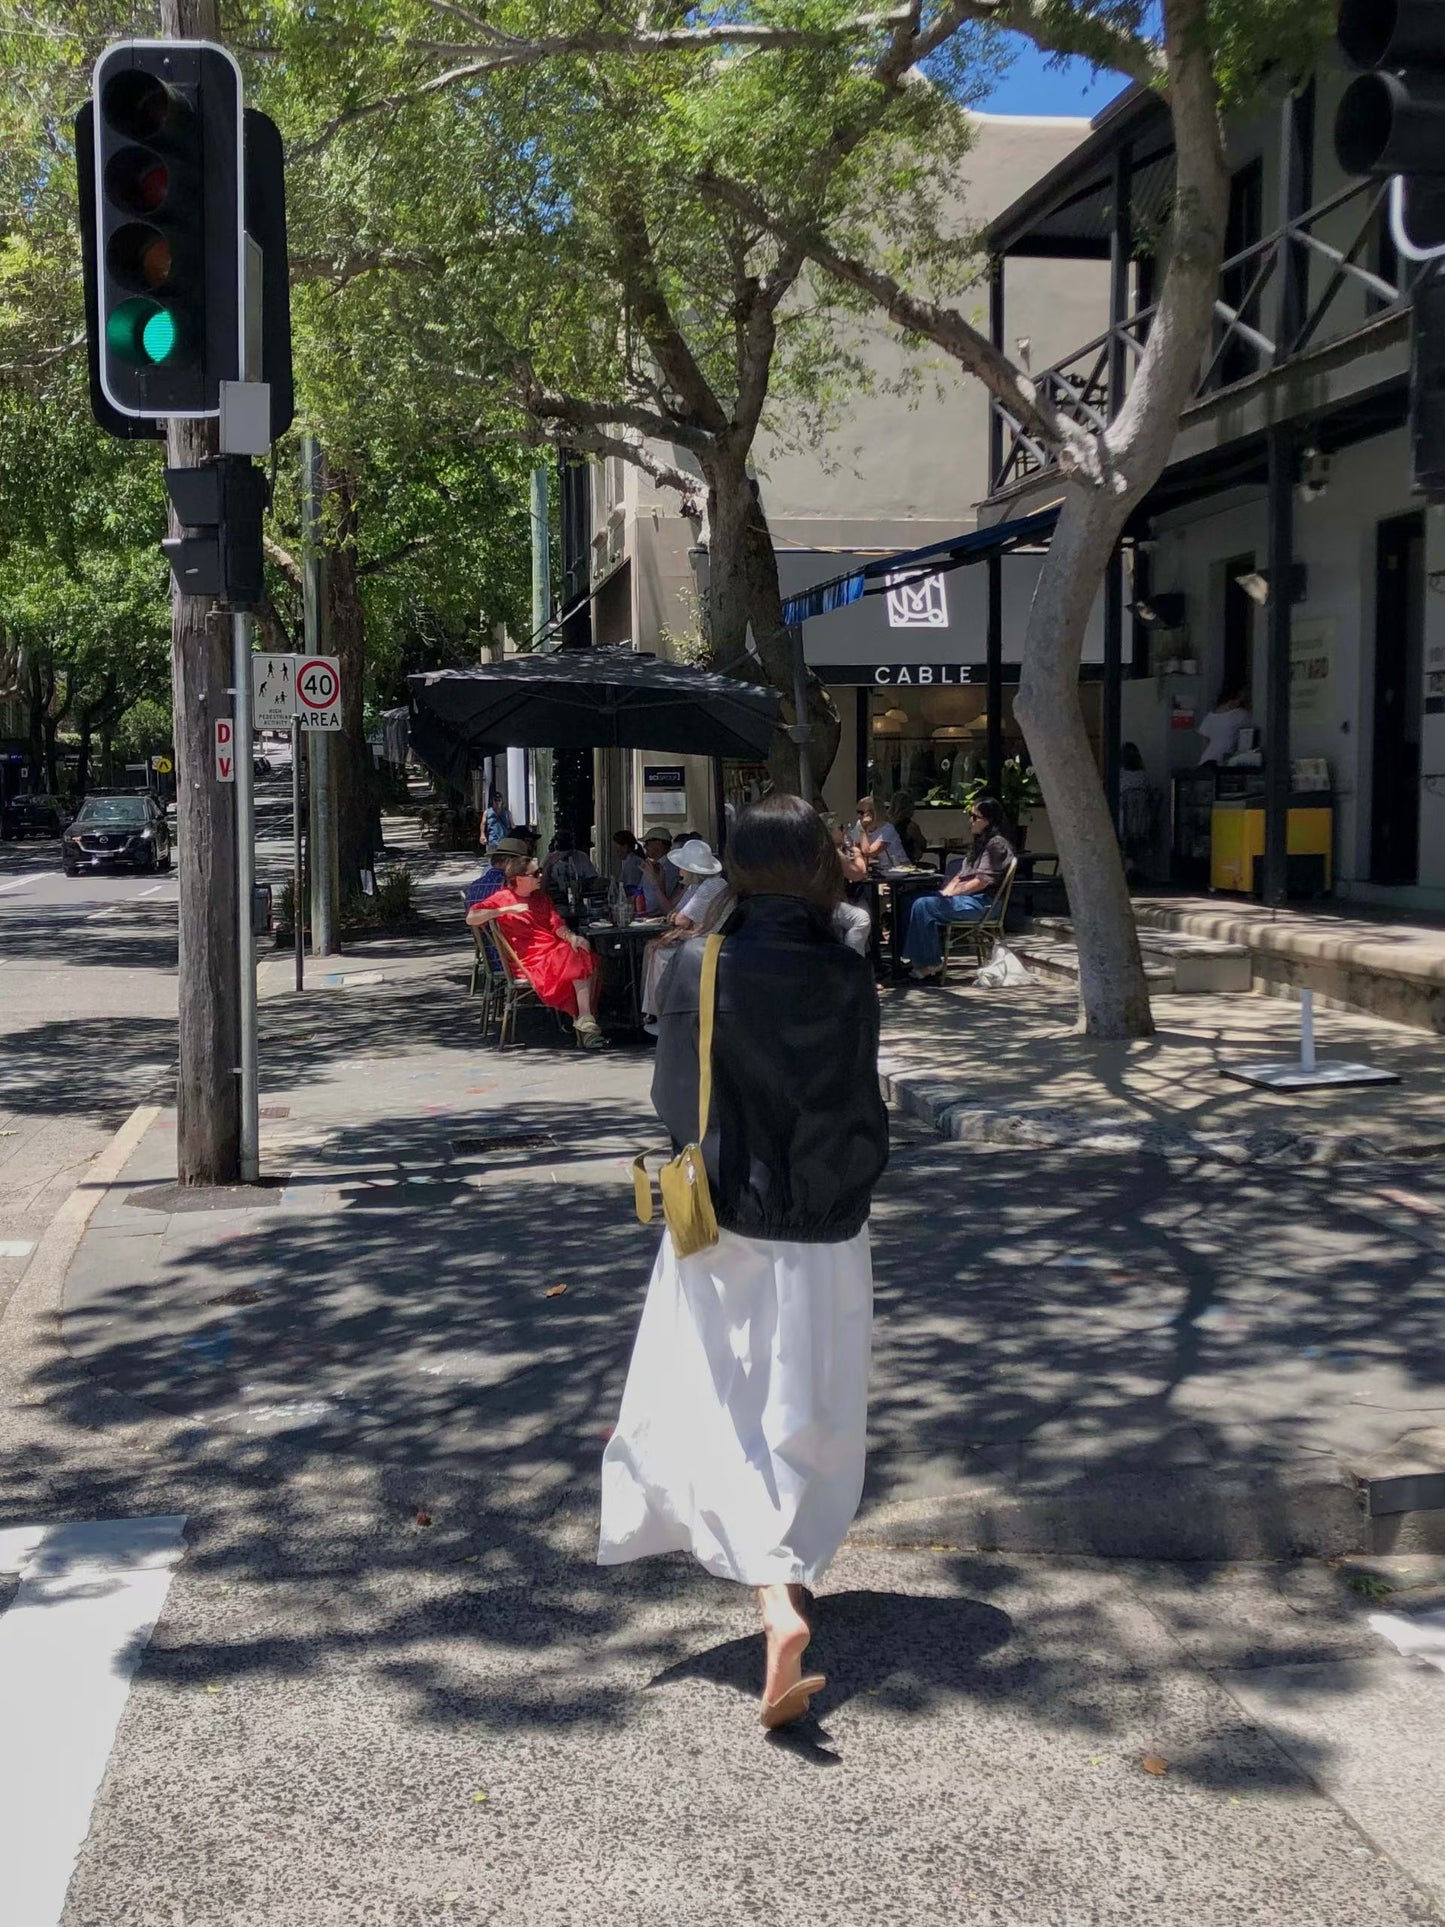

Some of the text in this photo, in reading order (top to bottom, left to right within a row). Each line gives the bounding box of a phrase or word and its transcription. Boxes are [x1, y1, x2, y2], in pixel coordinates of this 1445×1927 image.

[875, 666, 971, 684] CABLE
[304, 675, 332, 695] 40
[301, 712, 339, 726] AREA
